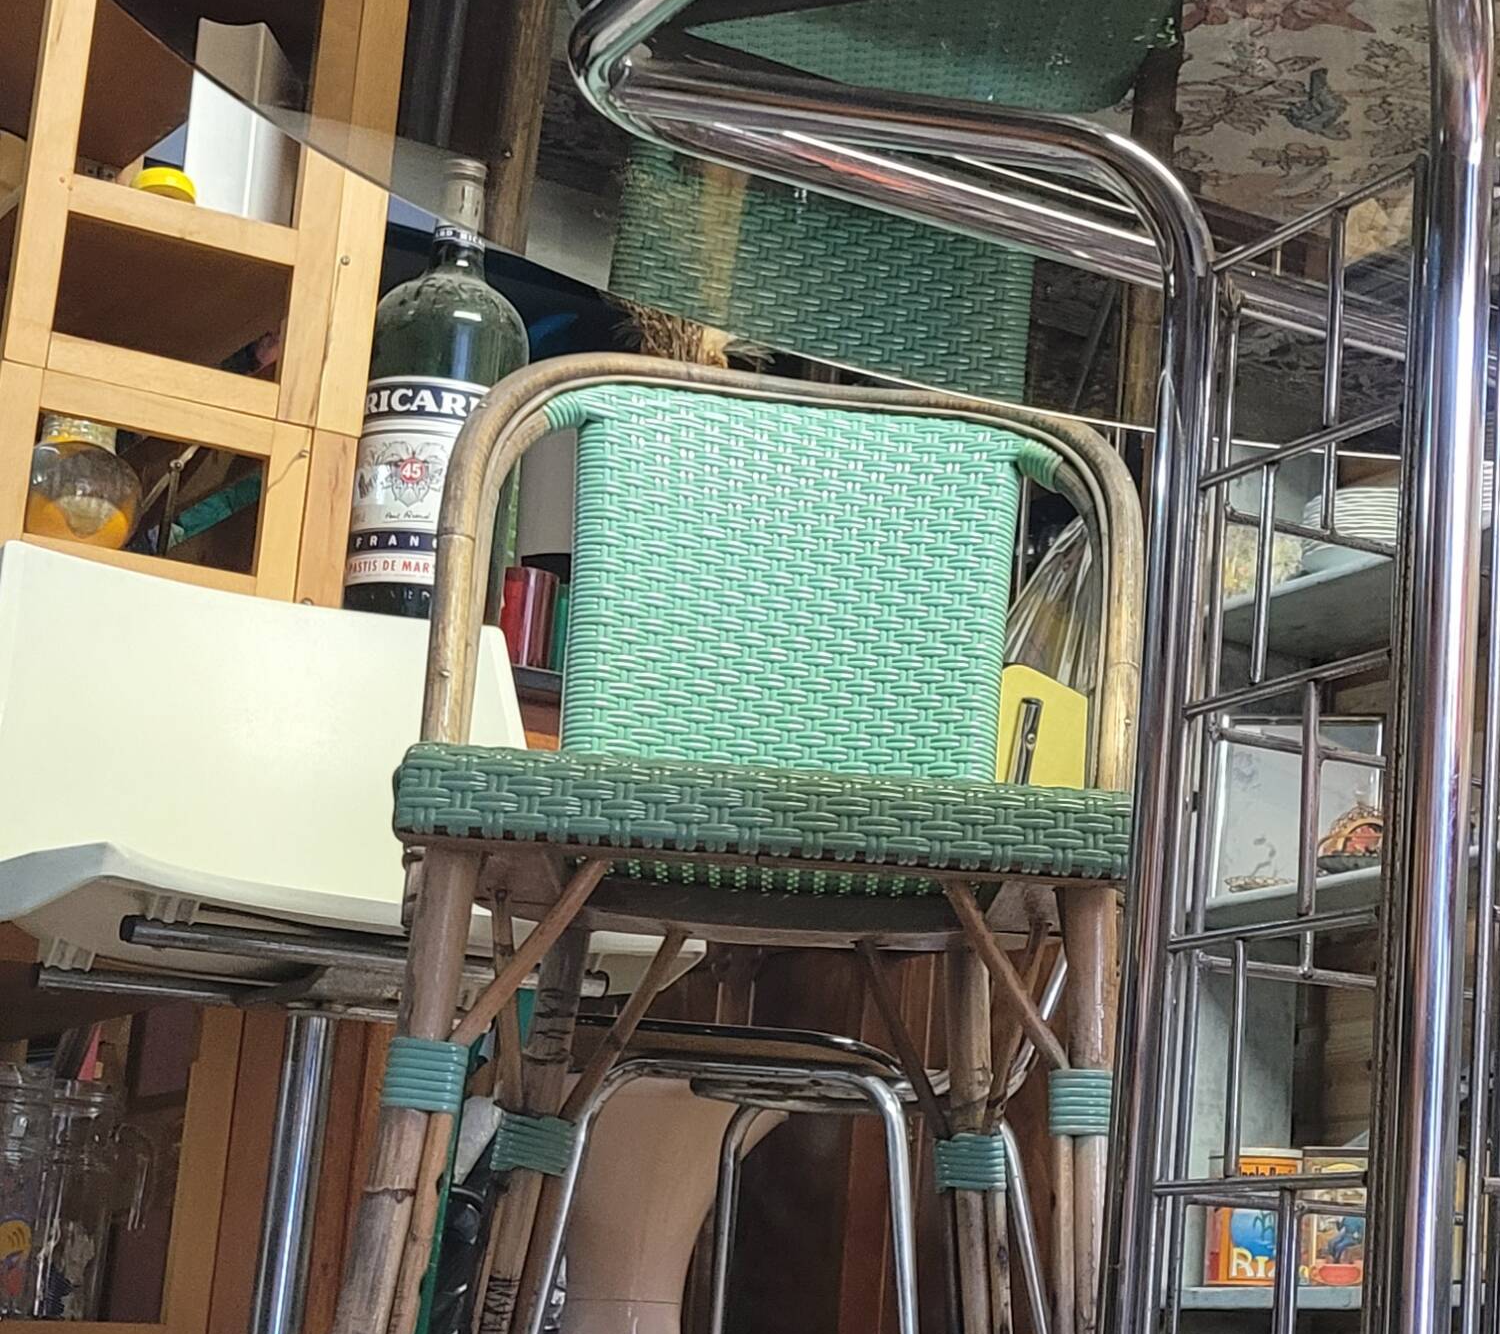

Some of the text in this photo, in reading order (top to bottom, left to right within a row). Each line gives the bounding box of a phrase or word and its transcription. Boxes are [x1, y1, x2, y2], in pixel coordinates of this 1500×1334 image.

[402, 463, 423, 479] 45
[382, 559, 397, 572] DE
[1230, 1246, 1276, 1278] RI
